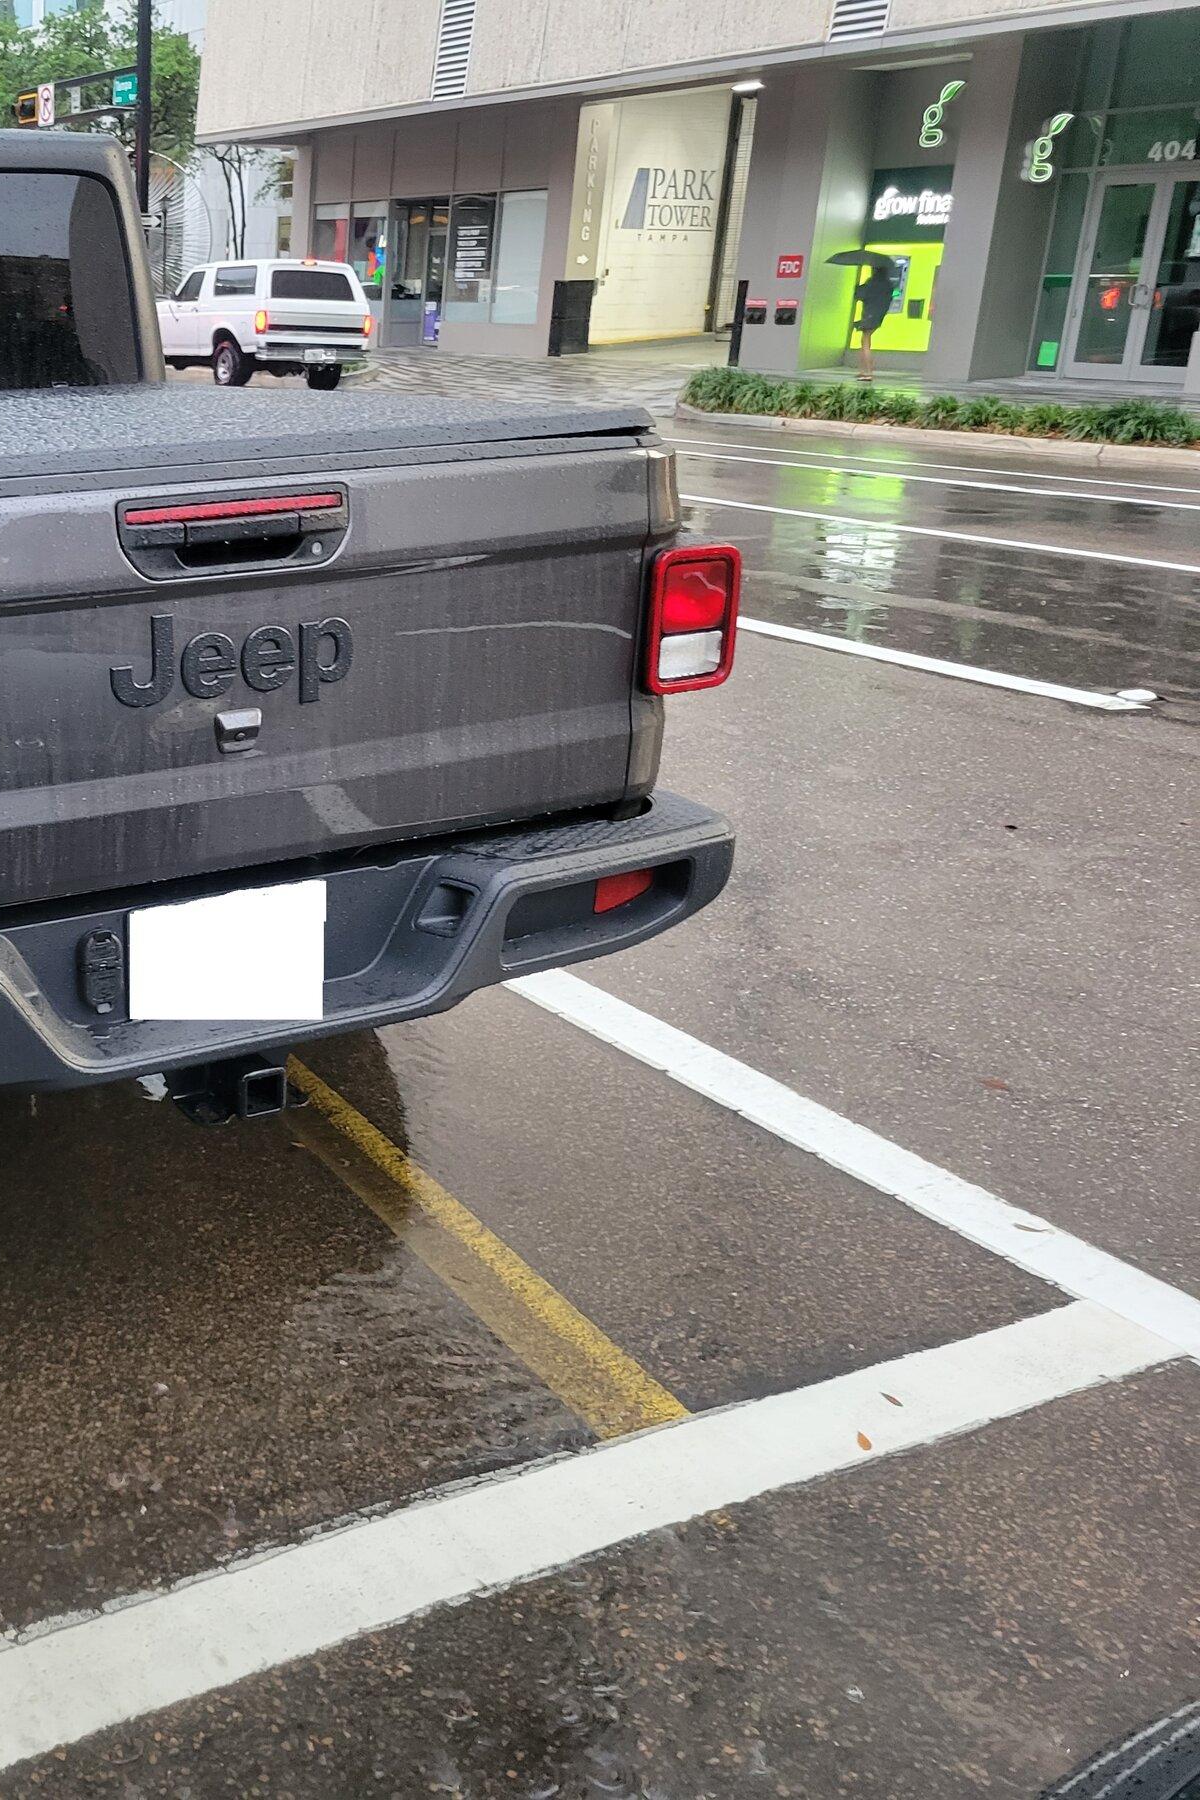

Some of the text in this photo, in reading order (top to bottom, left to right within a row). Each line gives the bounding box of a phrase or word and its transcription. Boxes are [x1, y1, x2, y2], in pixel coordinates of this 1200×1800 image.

[1148, 139, 1197, 162] 404
[581, 118, 600, 241] PARKING
[650, 168, 716, 201] PARK
[647, 204, 712, 228] TOWER
[873, 187, 918, 221] grow
[637, 233, 689, 242] TAMPA
[779, 261, 800, 274] FDC
[109, 613, 355, 709] Jeep
